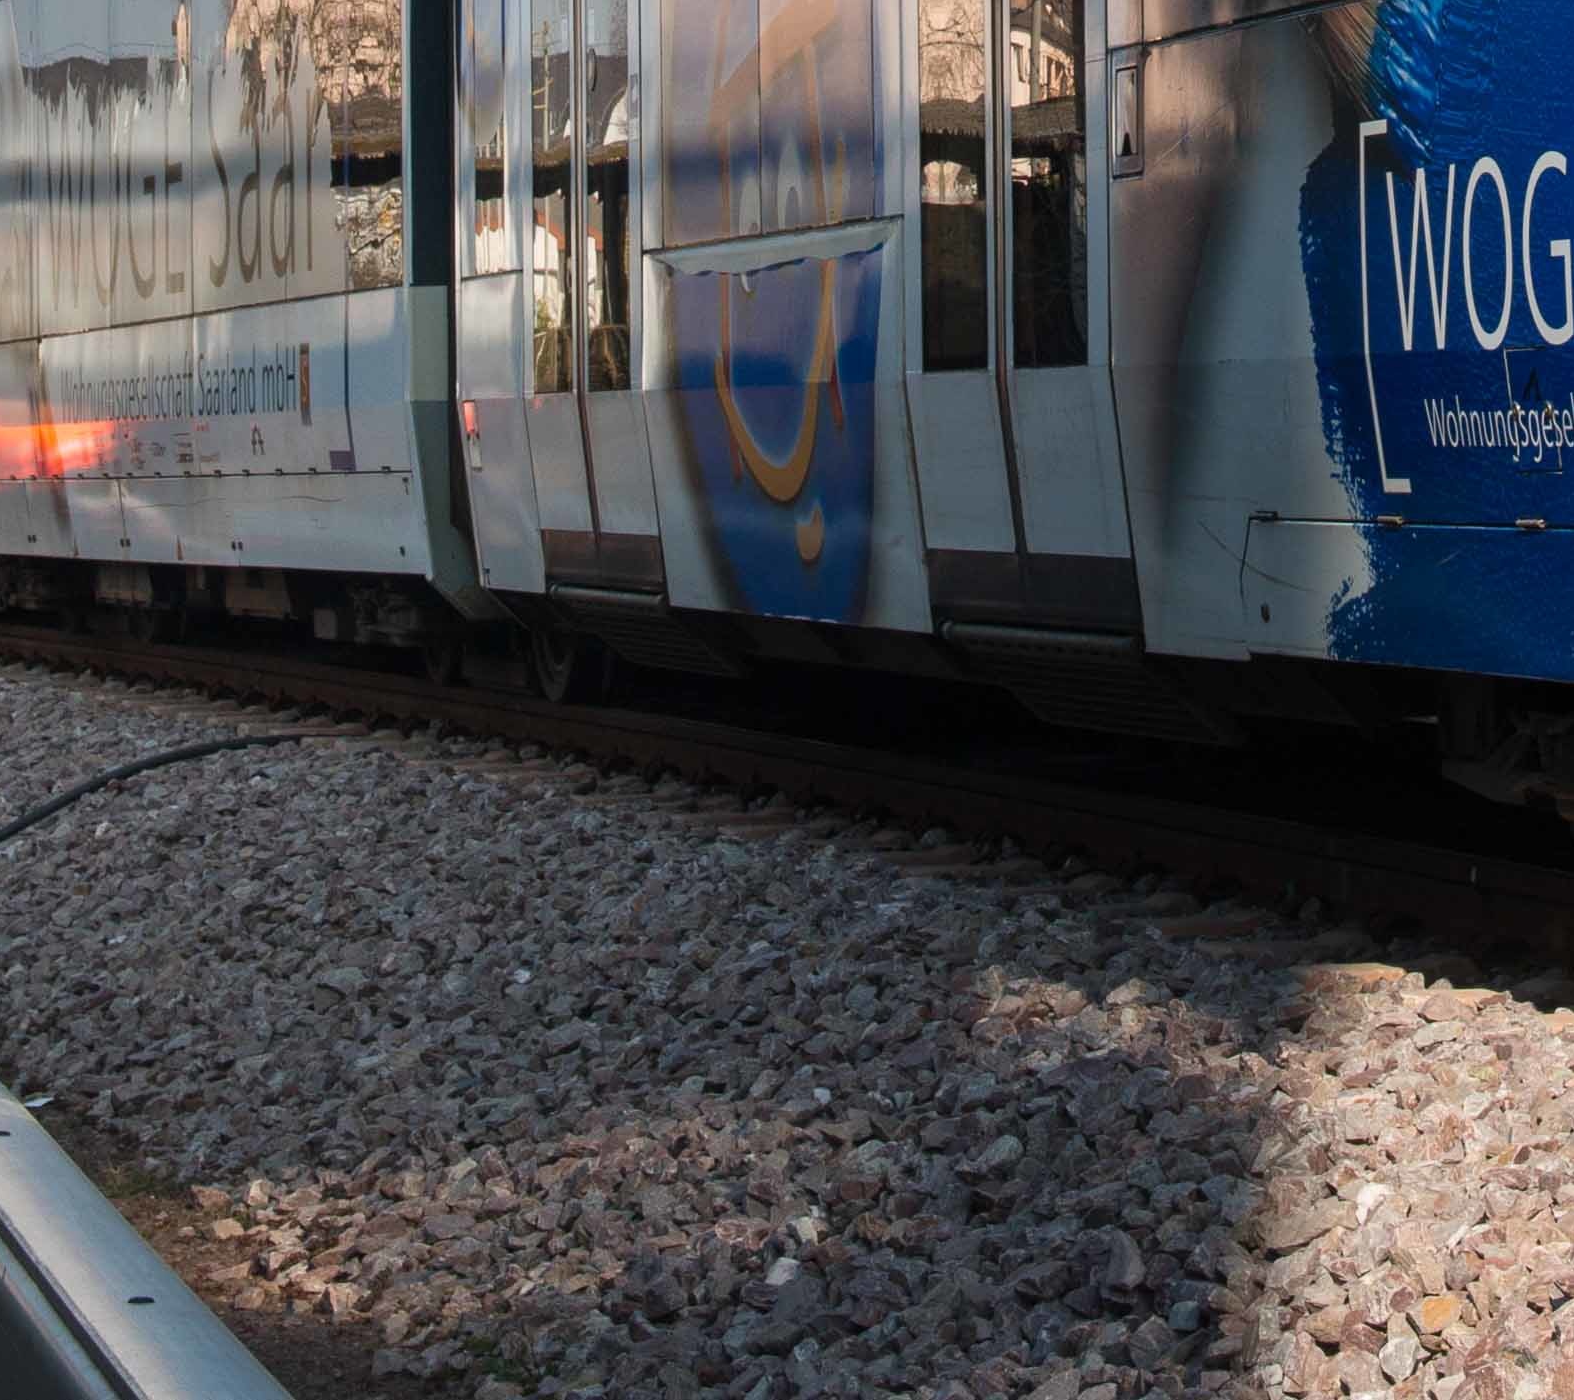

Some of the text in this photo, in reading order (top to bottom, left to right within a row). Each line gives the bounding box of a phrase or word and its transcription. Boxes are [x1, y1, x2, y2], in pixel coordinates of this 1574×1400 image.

[40, 65, 327, 312] WOGE Saar
[197, 343, 257, 416] Saarland
[262, 343, 297, 413] mbH
